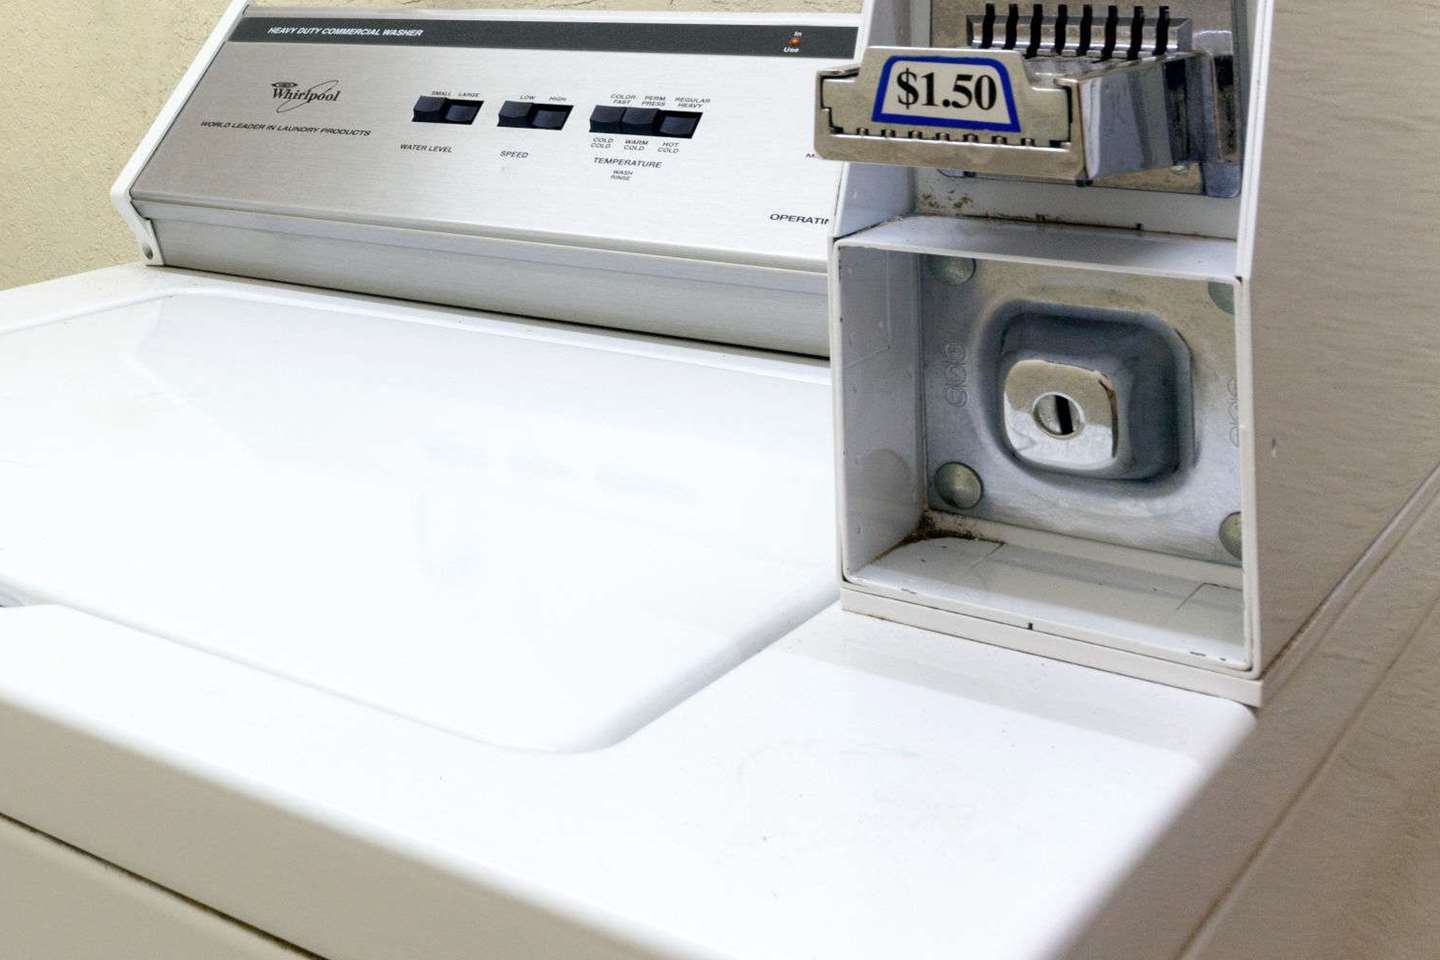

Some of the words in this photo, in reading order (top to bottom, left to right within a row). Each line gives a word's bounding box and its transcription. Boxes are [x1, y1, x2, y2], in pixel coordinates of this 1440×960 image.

[322, 28, 381, 36] COMMERCIAL
[382, 29, 424, 37] WASHER
[896, 67, 997, 111] $1.50
[272, 87, 341, 104] Whirlpool
[231, 122, 265, 130] LEADER
[277, 125, 320, 133] LAUNDRY
[320, 127, 372, 136] PRODUCTS
[399, 143, 428, 151] WATER
[428, 144, 453, 153] LEVEL
[499, 150, 529, 159] SPEED
[593, 157, 663, 169] TEMPERATURE
